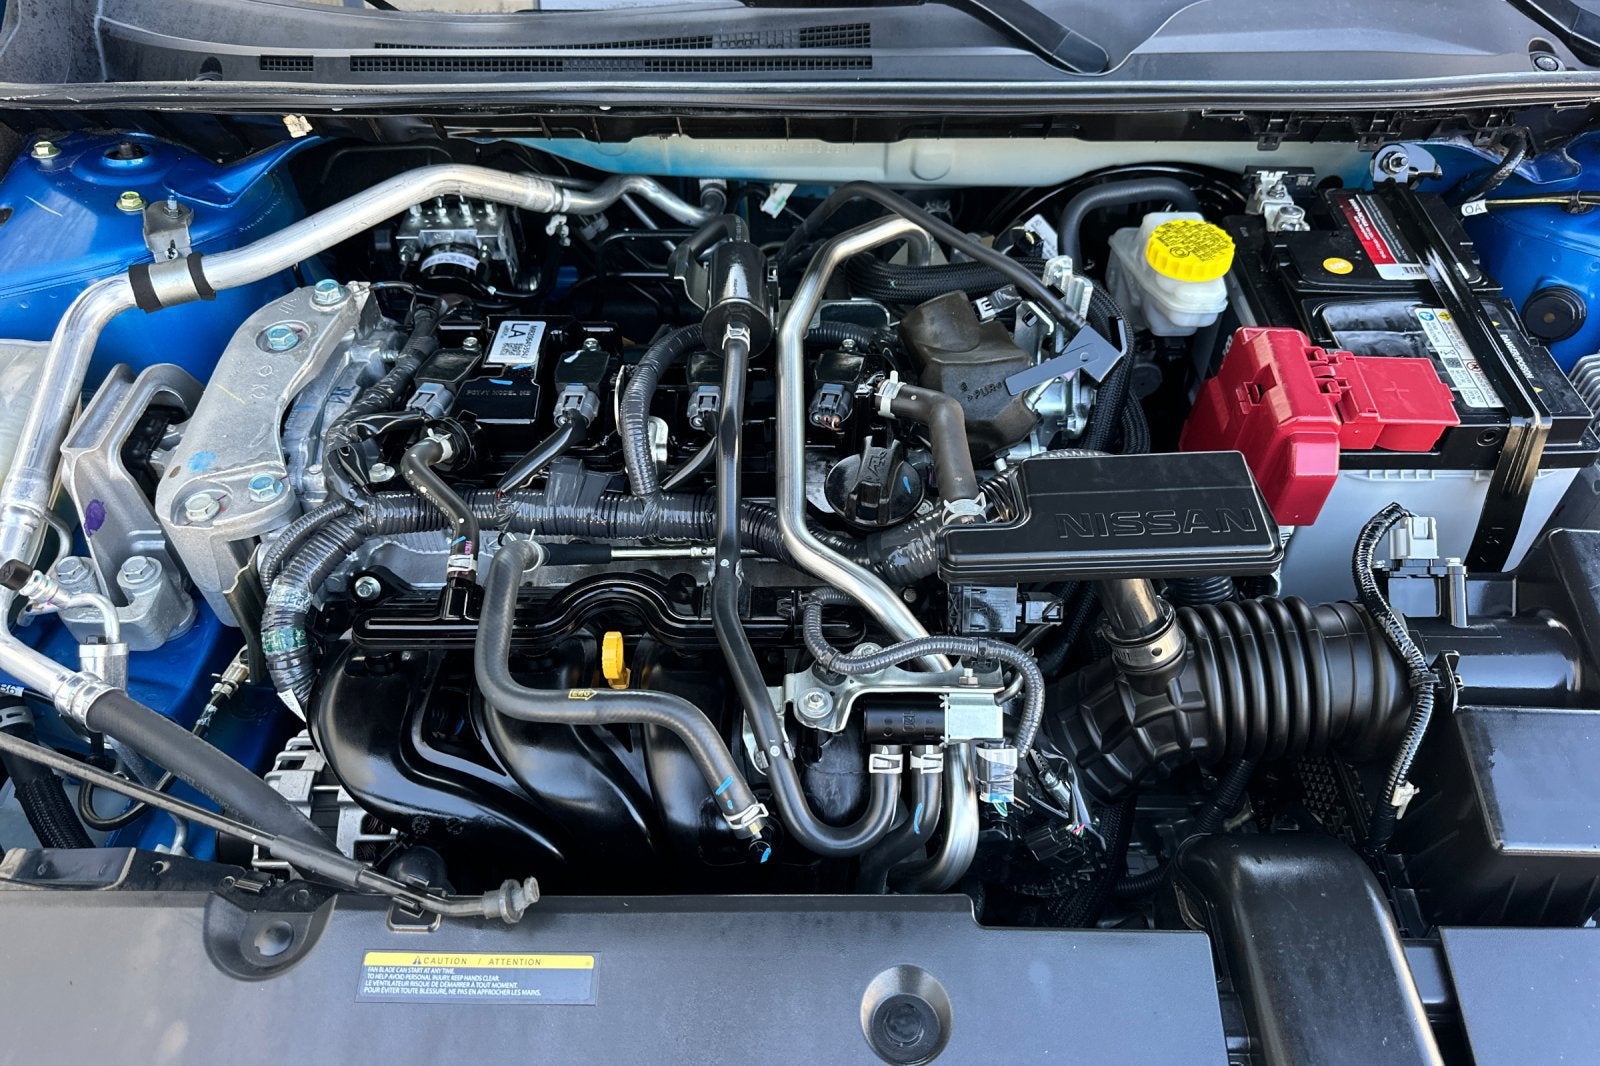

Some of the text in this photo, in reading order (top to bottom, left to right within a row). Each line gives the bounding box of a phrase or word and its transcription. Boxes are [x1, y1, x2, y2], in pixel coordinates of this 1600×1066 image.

[508, 323, 530, 338] LA
[1055, 508, 1257, 539] NISSAN
[423, 957, 467, 965] CAUTION
[488, 958, 542, 966] ATTENTION
